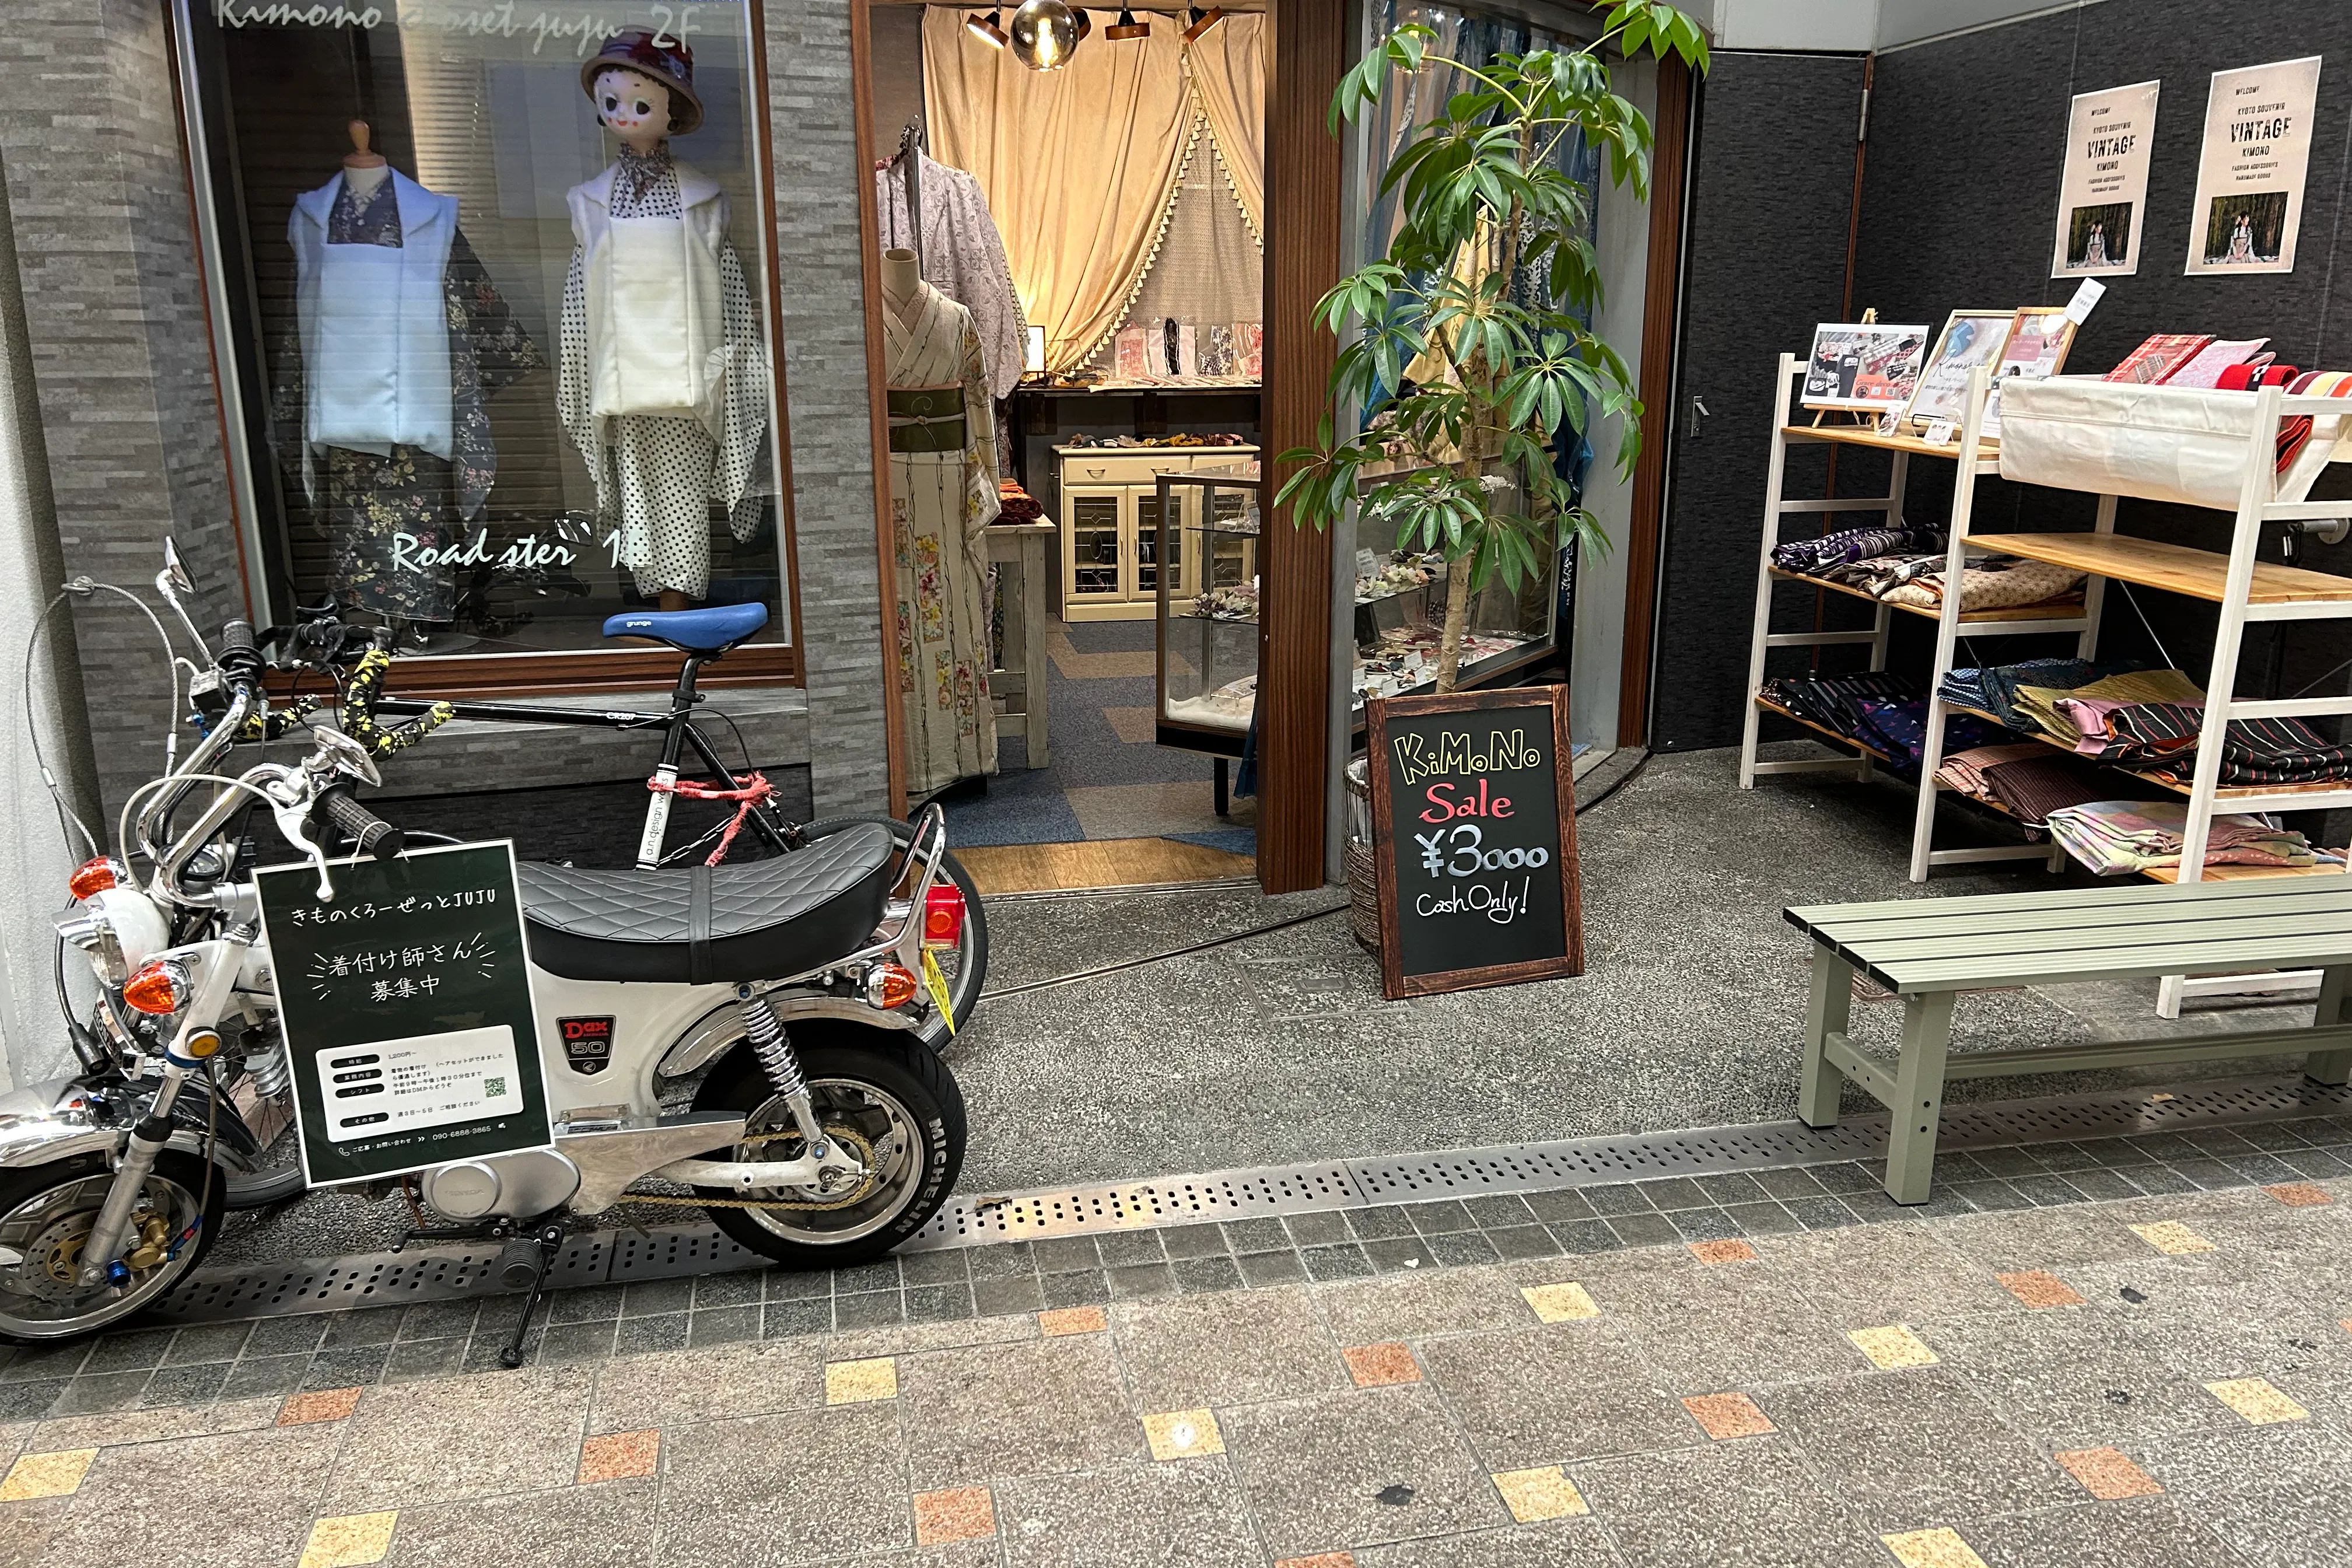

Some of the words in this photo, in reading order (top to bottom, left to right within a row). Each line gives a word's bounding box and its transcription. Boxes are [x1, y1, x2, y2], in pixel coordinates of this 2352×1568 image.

[650, 3, 702, 54] 2F
[2236, 86, 2260, 96] WELCOME
[2238, 106, 2256, 116] KYOTO
[2257, 102, 2286, 113] SOUVENIR
[2231, 117, 2292, 143] VINTAGE
[2088, 134, 2136, 159] VINTAGE
[2242, 145, 2270, 158] KIMONO
[2096, 160, 2119, 172] KIMONO
[1418, 778, 1516, 824] Sale
[1413, 824, 1549, 878] ¥3000
[291, 888, 496, 926] きものくろーぜっとJUJU
[328, 942, 472, 977] 着付け師さん
[370, 974, 440, 1002] 募集中
[564, 1021, 608, 1038] Dax
[570, 1041, 606, 1054] 50
[350, 1087, 370, 1096] シフト
[355, 1115, 376, 1125] その他
[895, 1118, 947, 1234] MICHELIN
